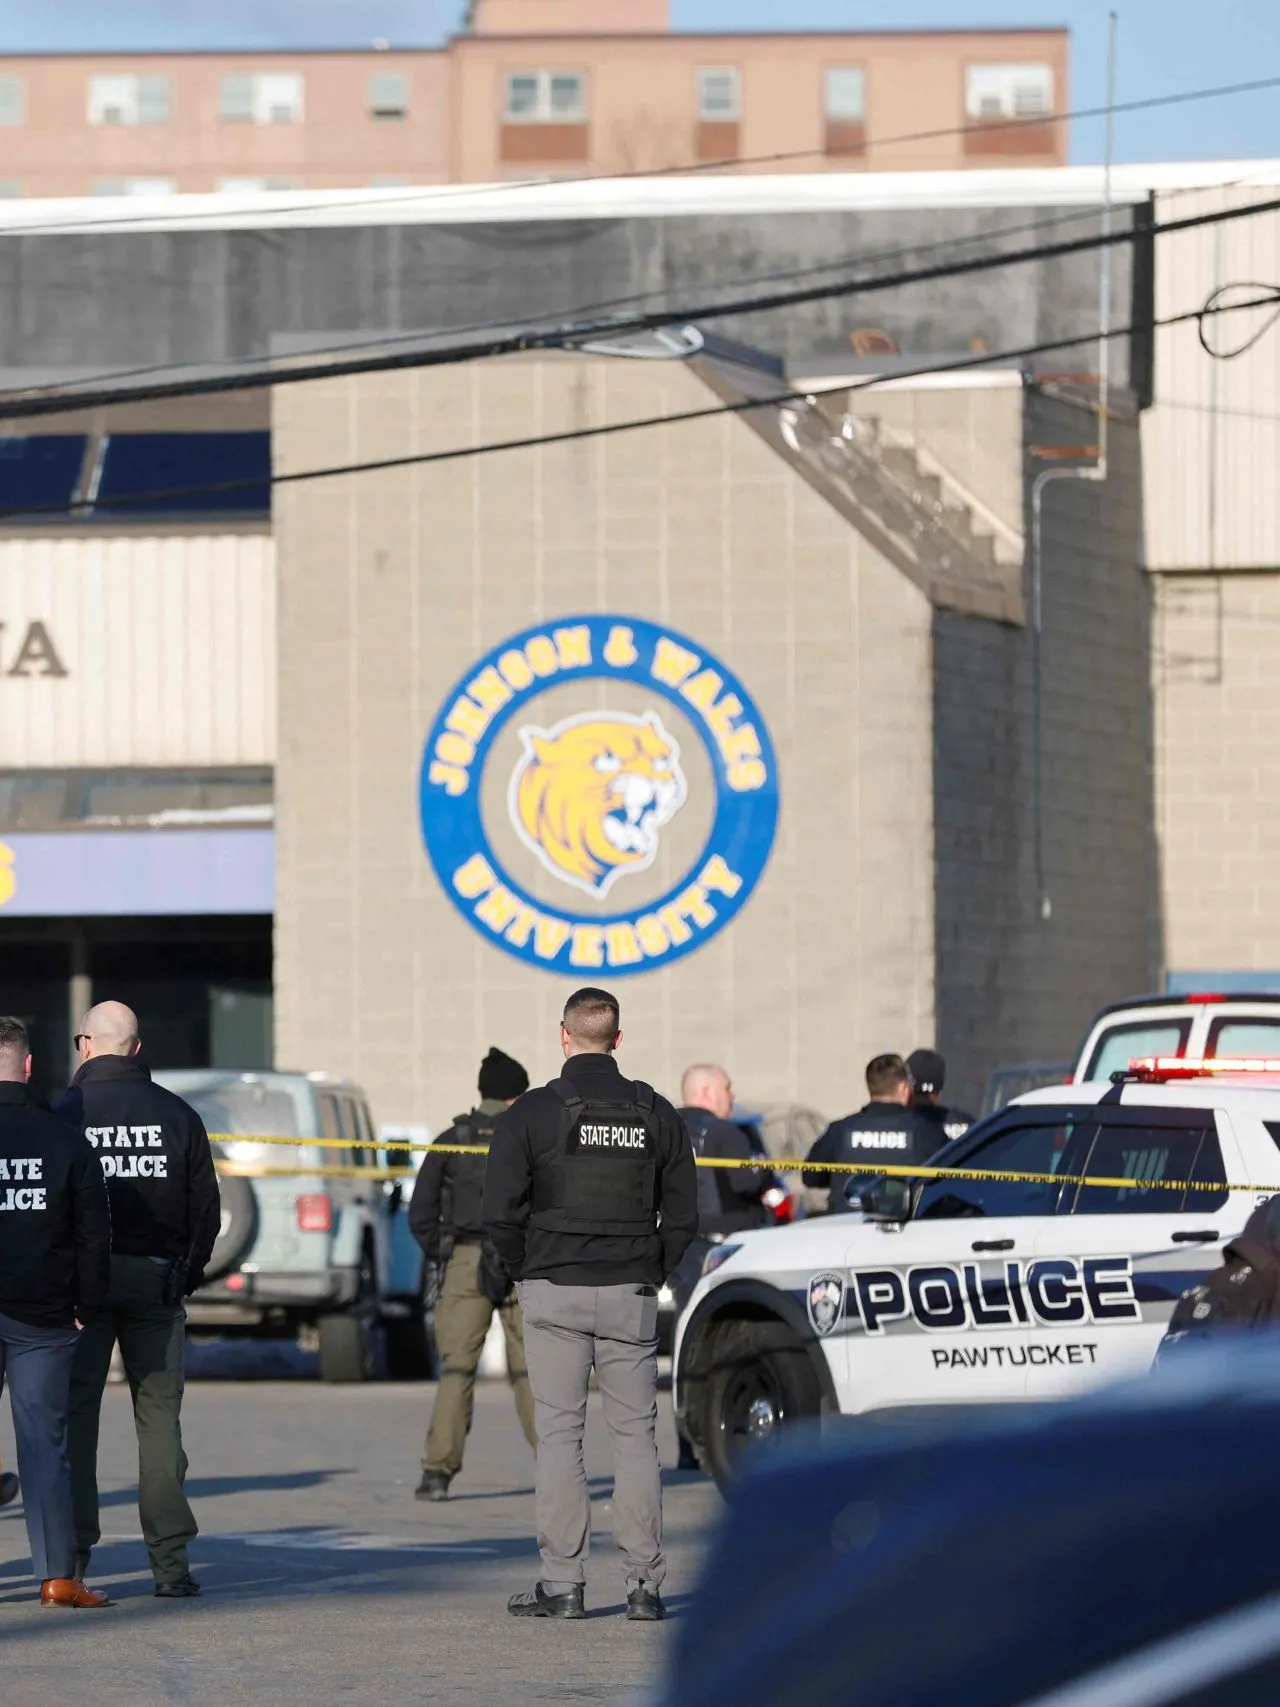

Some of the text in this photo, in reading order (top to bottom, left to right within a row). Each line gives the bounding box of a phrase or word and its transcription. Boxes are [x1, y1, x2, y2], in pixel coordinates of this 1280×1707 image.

[428, 625, 593, 796] JOHNSON
[651, 637, 767, 792] WALES
[452, 852, 744, 968] UNIVERSITY
[85, 1125, 162, 1148] STATE
[580, 1125, 645, 1148] STATE POLICE
[851, 1130, 907, 1149] POLICE
[100, 1154, 168, 1178] OLICE
[850, 1254, 1142, 1336] POLICE
[931, 1344, 1098, 1369] PAWTUCKET
